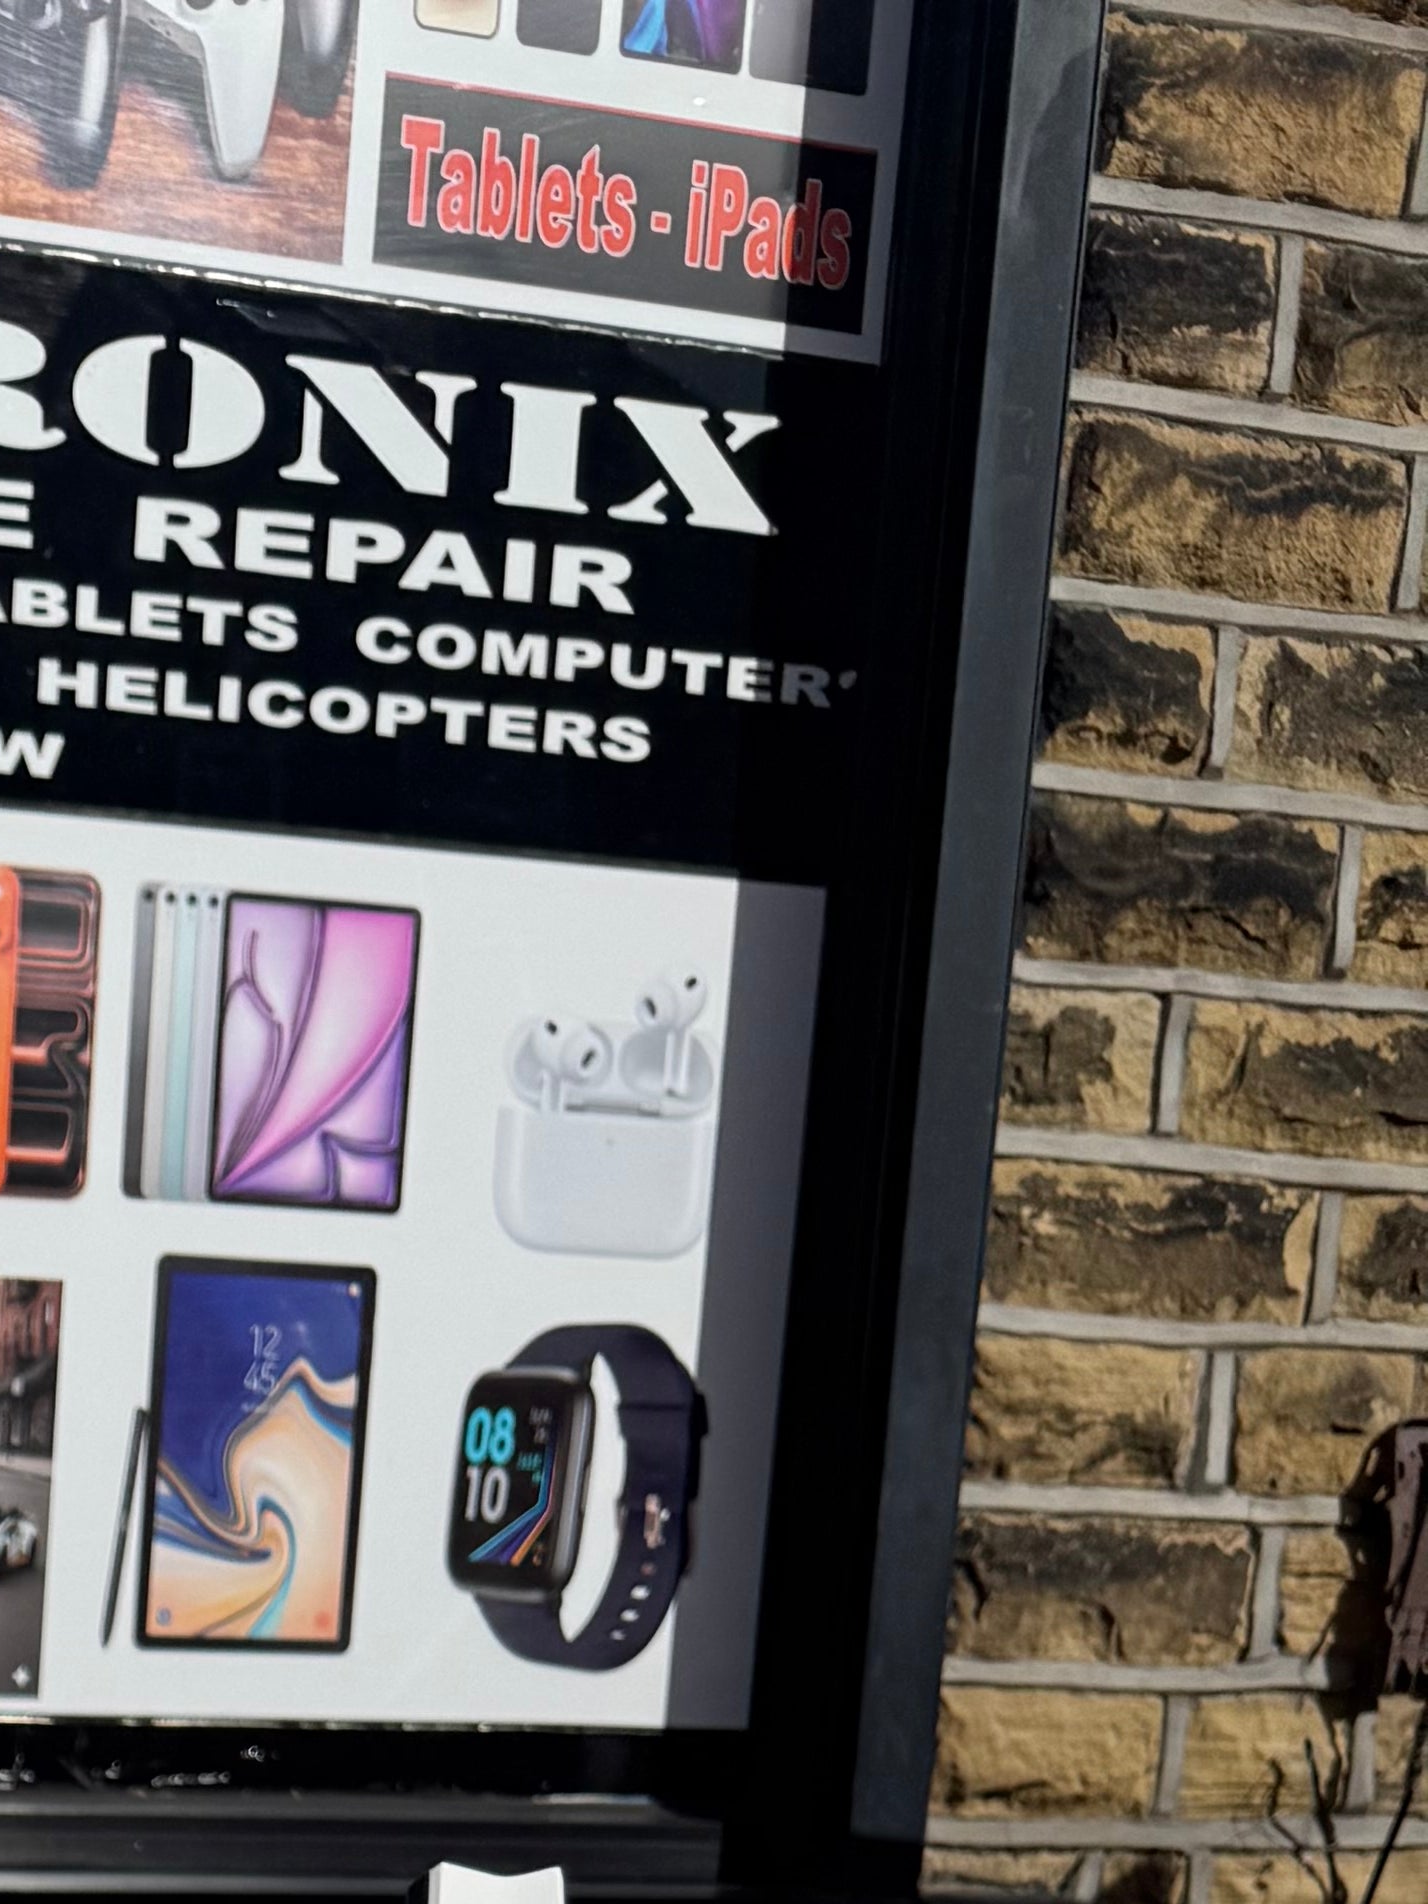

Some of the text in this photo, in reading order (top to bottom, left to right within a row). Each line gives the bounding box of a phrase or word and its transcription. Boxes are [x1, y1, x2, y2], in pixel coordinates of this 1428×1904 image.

[401, 113, 638, 258] Tablets
[684, 159, 853, 290] iPads
[133, 495, 635, 615] REPAIR
[36, 656, 651, 763] HELICOPTERS
[355, 615, 858, 708] COMPUTER
[464, 1406, 516, 1464] 08
[464, 1464, 510, 1523] 10
